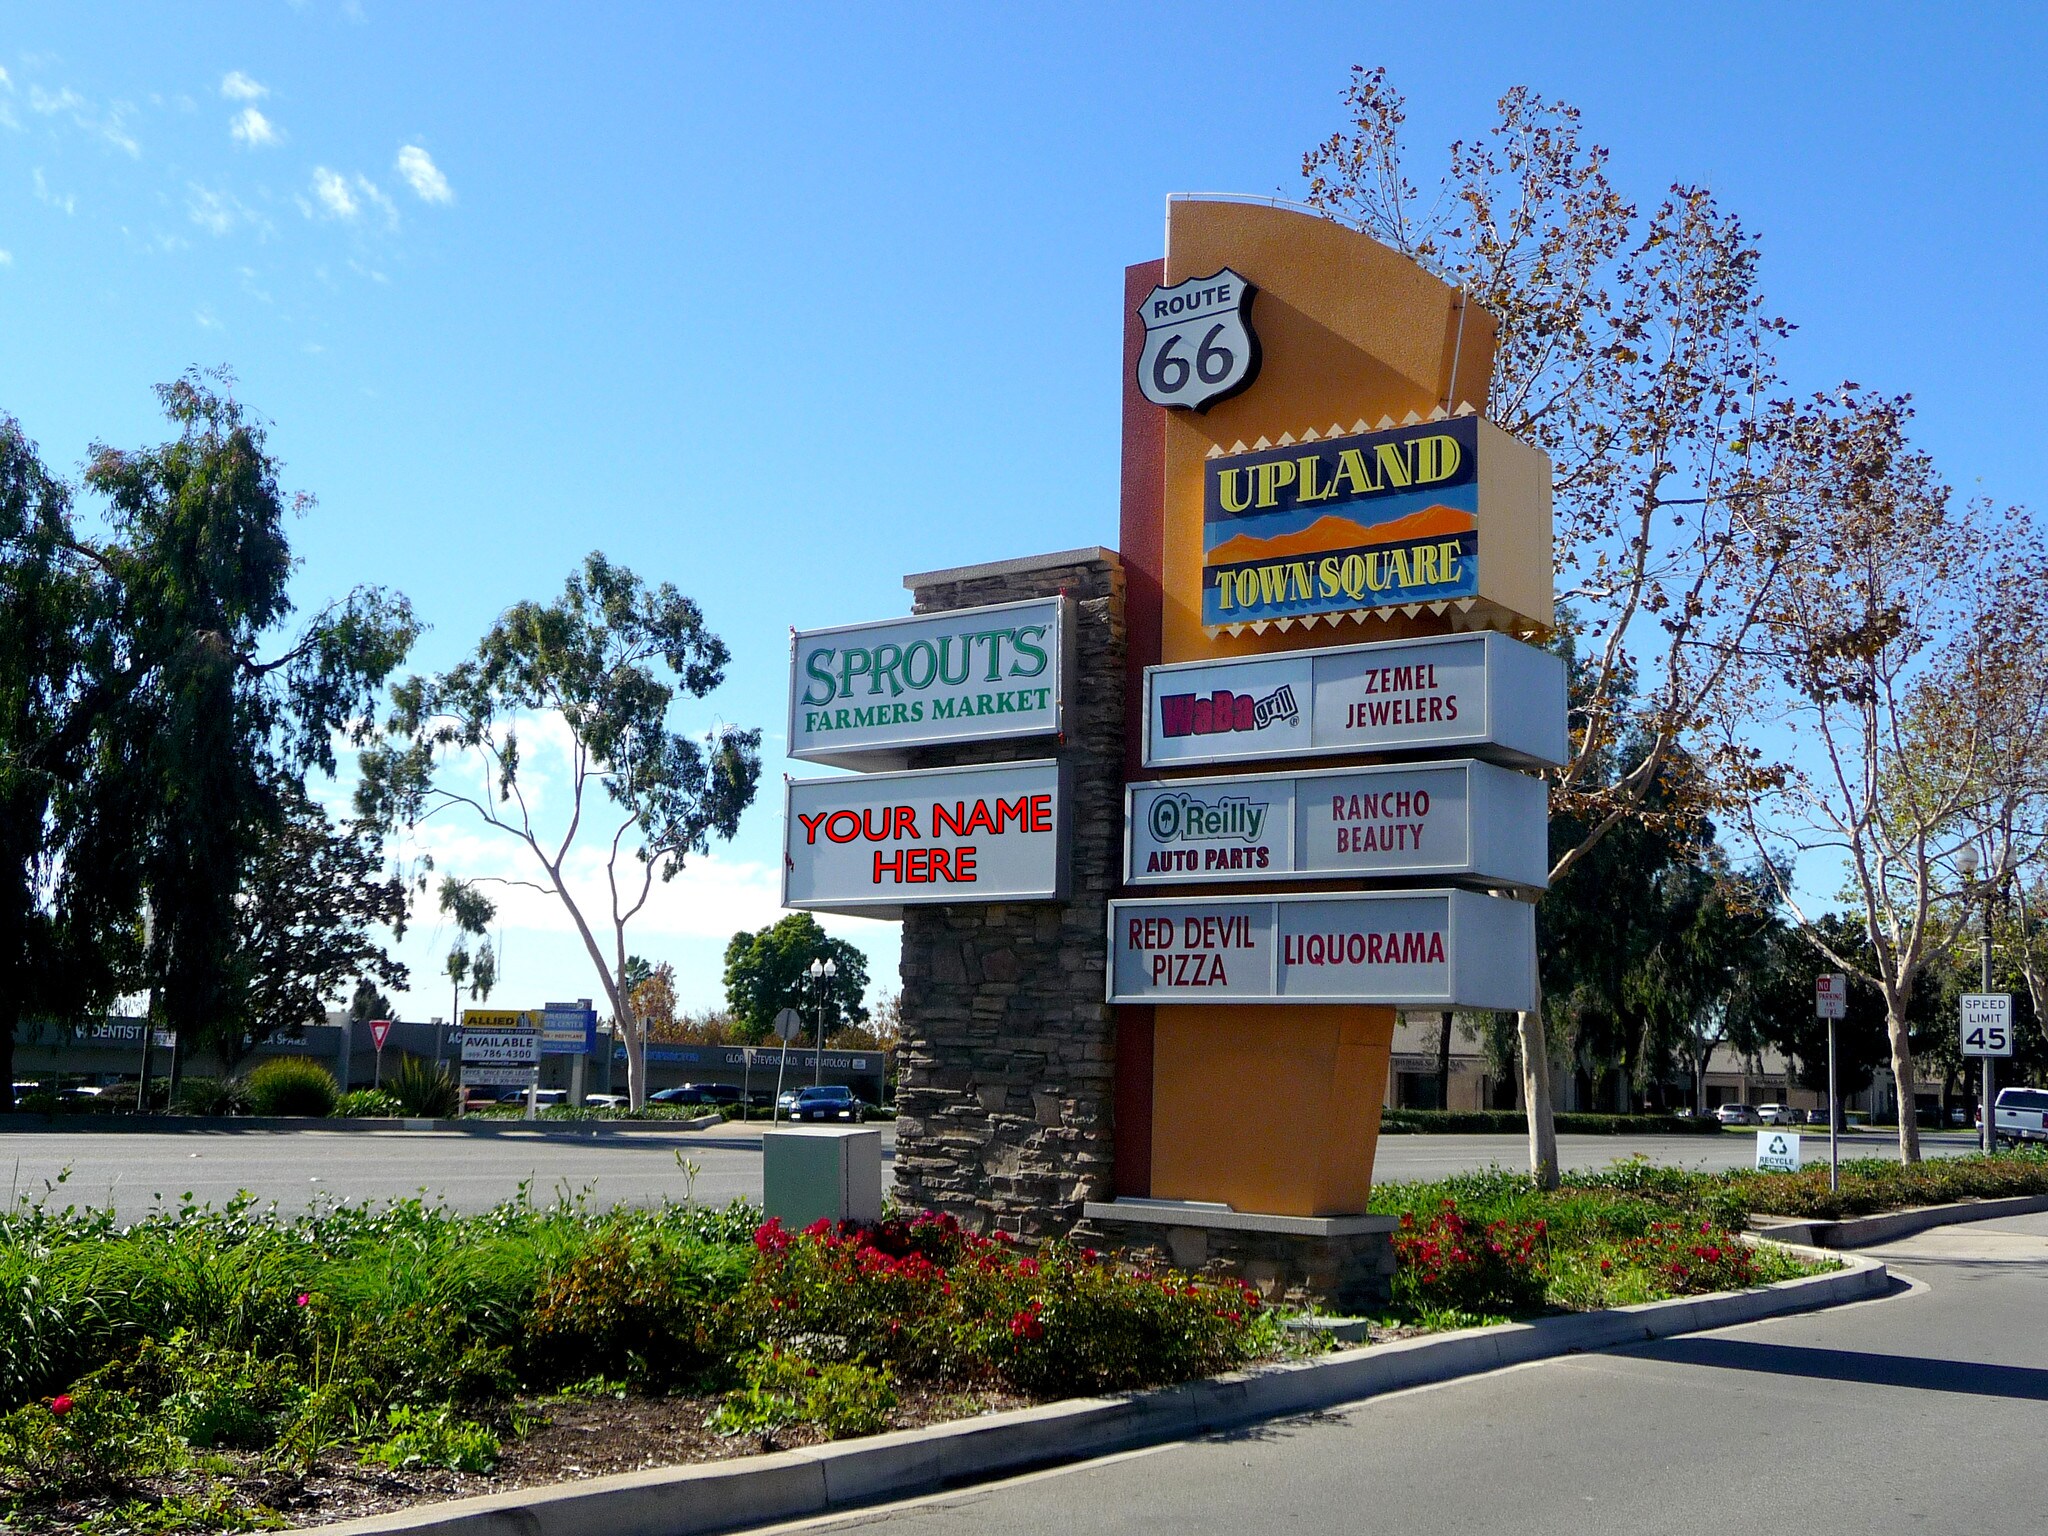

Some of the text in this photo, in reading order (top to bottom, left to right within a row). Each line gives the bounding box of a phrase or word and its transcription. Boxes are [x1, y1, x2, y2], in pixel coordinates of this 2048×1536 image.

[1153, 283, 1231, 318] ROUTE
[1152, 322, 1234, 394] 66
[1217, 434, 1462, 514] UPLAND
[1215, 539, 1462, 610] TOWN SQUARE
[800, 624, 1049, 707] SPROUTS
[1365, 664, 1438, 694] ZEMEL
[805, 687, 1051, 733] FARMERS MARKET
[1160, 687, 1296, 738] WaBa grill
[1346, 695, 1457, 729] JEWELERS
[798, 794, 1053, 845] YOUR NAME
[1153, 798, 1263, 838] O'Reilly
[1332, 790, 1430, 821] RANCHO
[1337, 823, 1424, 853] BEAUTY
[873, 846, 977, 884] HERE
[1147, 846, 1270, 873] AUTO PARTS
[1128, 915, 1255, 950] RED DEVIL
[1284, 931, 1445, 966] LIQUORAMA
[1152, 954, 1228, 987] PIZZA
[1818, 981, 1829, 990] NO
[1965, 999, 2006, 1010] SPEED
[1969, 1013, 2002, 1023] LIMIT
[91, 1023, 142, 1039] DENTIST
[467, 1016, 515, 1026] ALLIED
[465, 1037, 533, 1048] AVAILABLE
[483, 1049, 532, 1059] 786-4300
[1965, 1027, 2006, 1050] 45
[752, 1055, 782, 1065] STEVENS
[1759, 1156, 1794, 1165] RECYCLE
